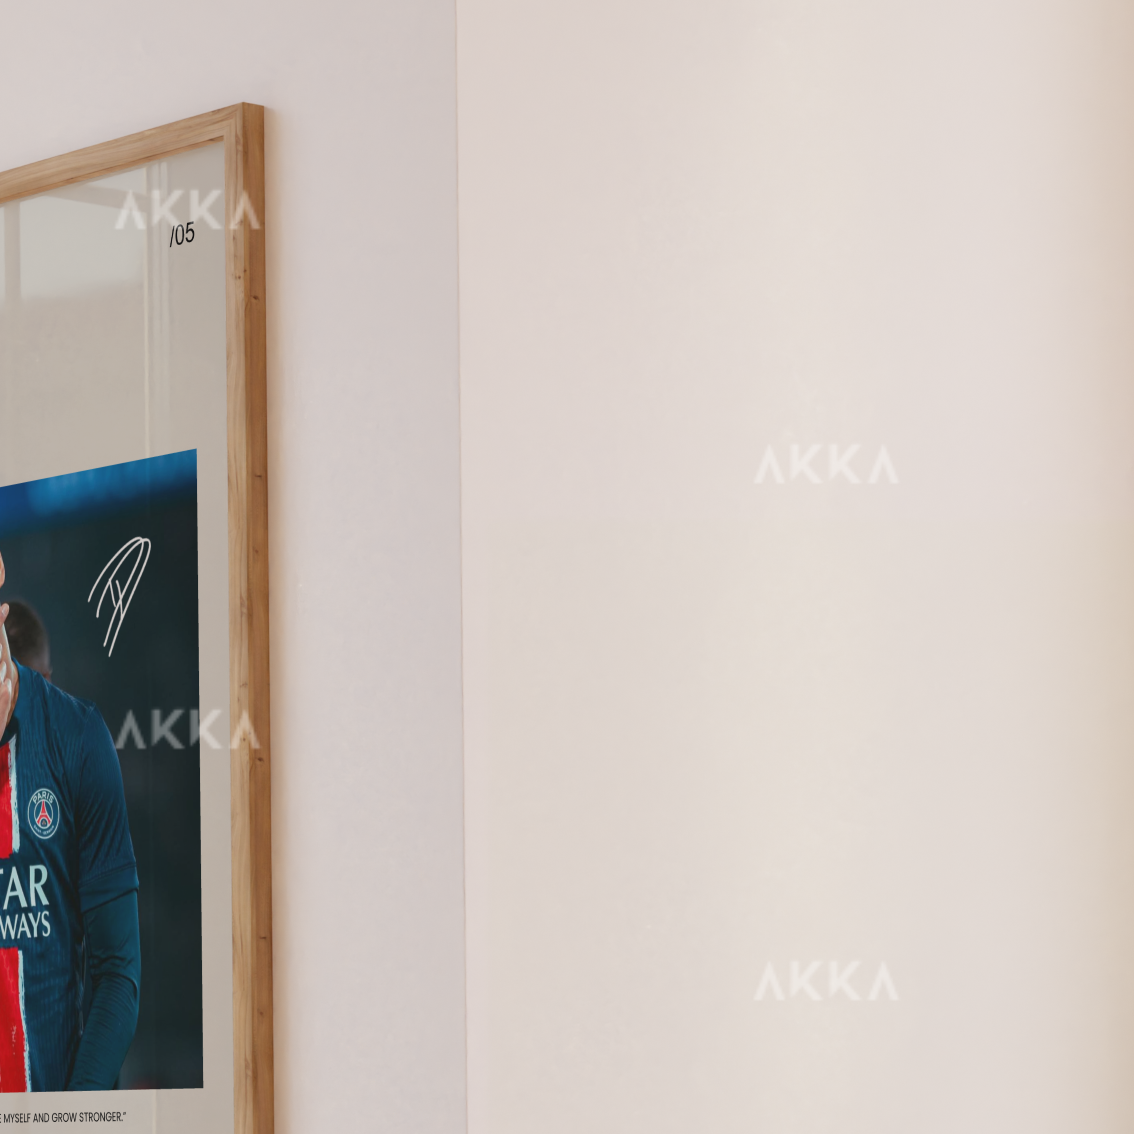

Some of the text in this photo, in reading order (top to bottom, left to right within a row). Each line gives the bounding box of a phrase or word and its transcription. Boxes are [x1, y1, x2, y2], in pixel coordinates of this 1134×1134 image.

[169, 221, 195, 248] /05
[32, 791, 54, 804] PARIS
[4, 1113, 30, 1124] MYSELF
[33, 1113, 50, 1123] AND
[52, 1112, 77, 1123] GROW
